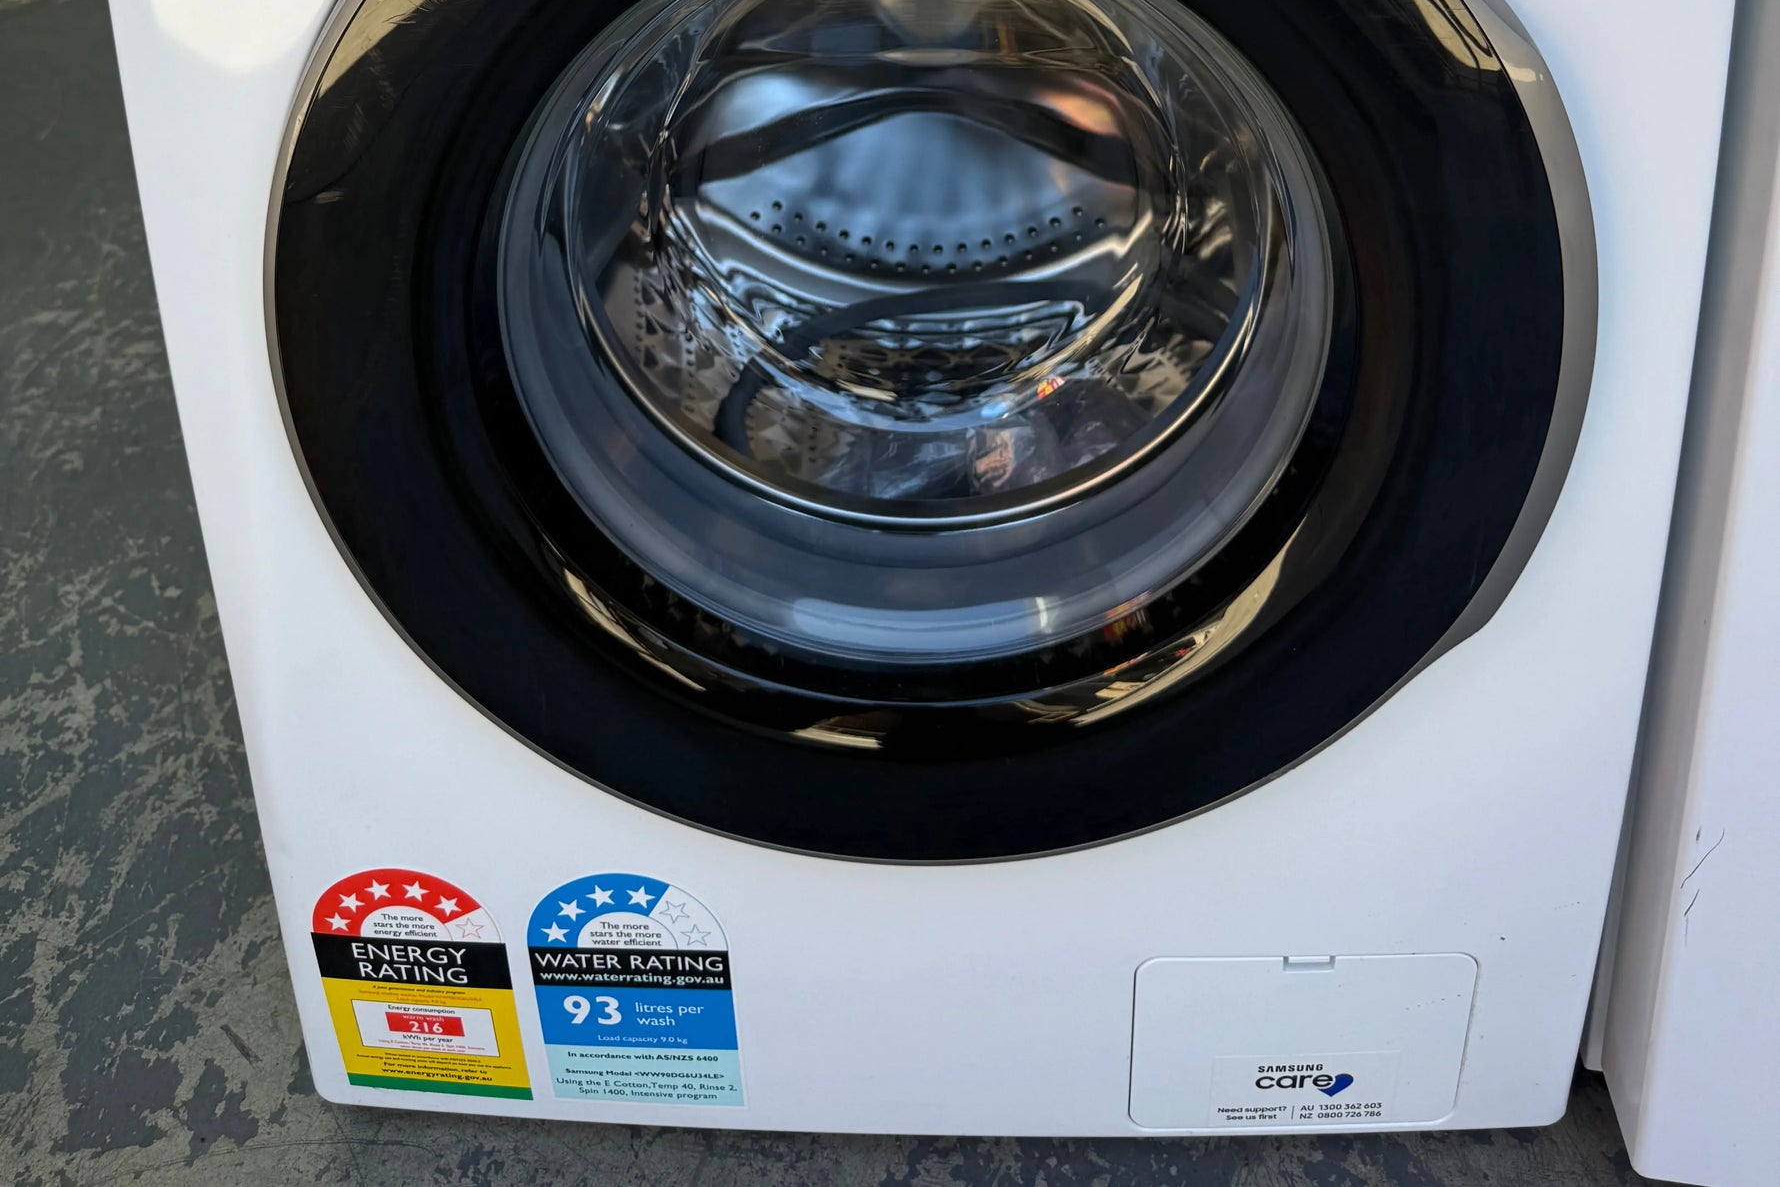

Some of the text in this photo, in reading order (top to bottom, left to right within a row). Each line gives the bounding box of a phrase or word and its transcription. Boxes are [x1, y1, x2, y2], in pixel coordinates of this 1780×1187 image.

[381, 913, 399, 921] The
[600, 921, 649, 931] The more
[374, 929, 438, 938] energy efficient
[590, 930, 613, 938] stars
[616, 930, 633, 938] the
[623, 939, 662, 947] efficient
[351, 942, 467, 965] ENERGY
[534, 952, 724, 972] WATER RATING
[358, 961, 468, 984] RATING
[539, 971, 725, 986] www.waterrating.gov.au
[388, 1004, 456, 1014] Energy consumption
[563, 995, 704, 1025] 93 litres per
[636, 1016, 676, 1026] wash
[408, 1020, 444, 1034] 216
[677, 1037, 688, 1045] kg
[579, 1052, 632, 1060] accordance
[655, 1054, 694, 1062] AS/NZS
[565, 1068, 604, 1076] Samsung
[605, 1069, 633, 1077] Model
[1257, 1064, 1324, 1073] SAMSUNG
[381, 1068, 493, 1082] www.energyrating.gov.au
[556, 1077, 584, 1087] Using
[585, 1079, 601, 1087] the
[699, 1083, 726, 1091] Rinse
[1255, 1074, 1334, 1090] care
[578, 1087, 599, 1096] Spin
[631, 1090, 674, 1098] Intensive
[676, 1092, 718, 1101] program
[1244, 1105, 1287, 1114] support?
[1318, 1103, 1343, 1111] 1300
[1344, 1102, 1362, 1110] 362
[1317, 1111, 1343, 1119] 0800
